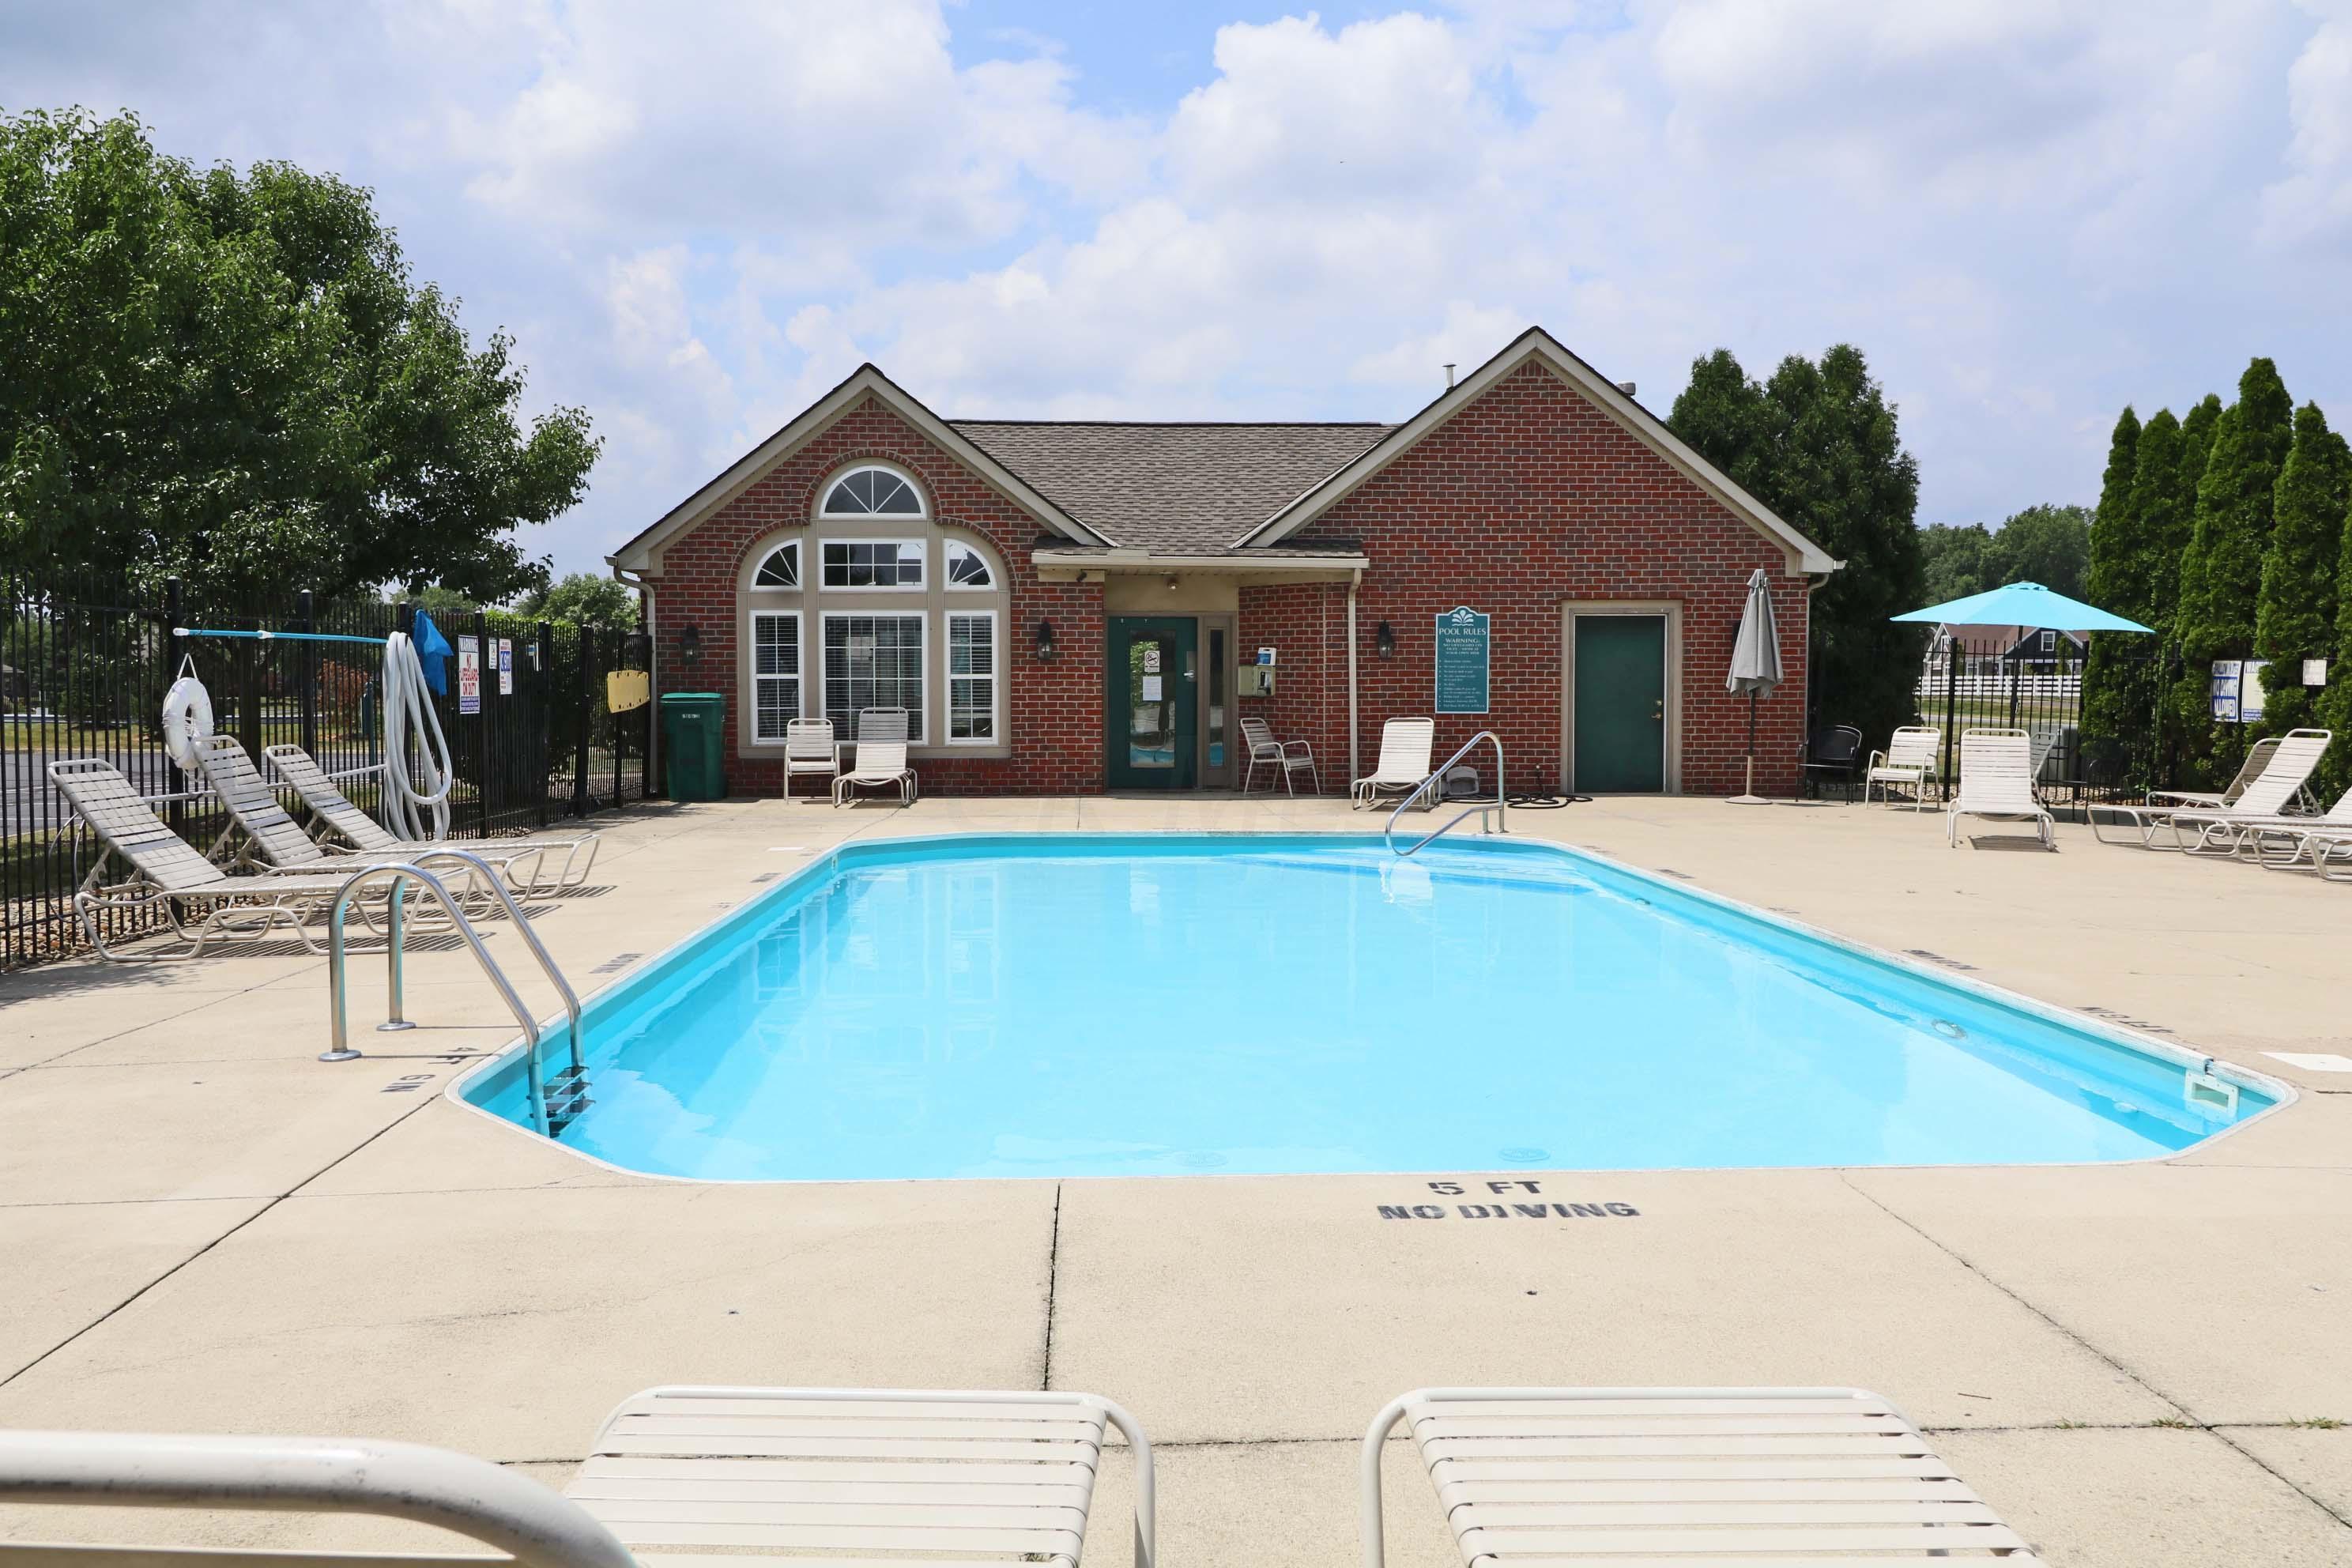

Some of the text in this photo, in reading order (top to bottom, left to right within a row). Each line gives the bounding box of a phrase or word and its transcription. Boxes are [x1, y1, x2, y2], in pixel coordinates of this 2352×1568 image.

[466, 654, 472, 669] NO
[1427, 1181, 1542, 1196] 5 FT
[1376, 1202, 1642, 1219] NO DIVING
